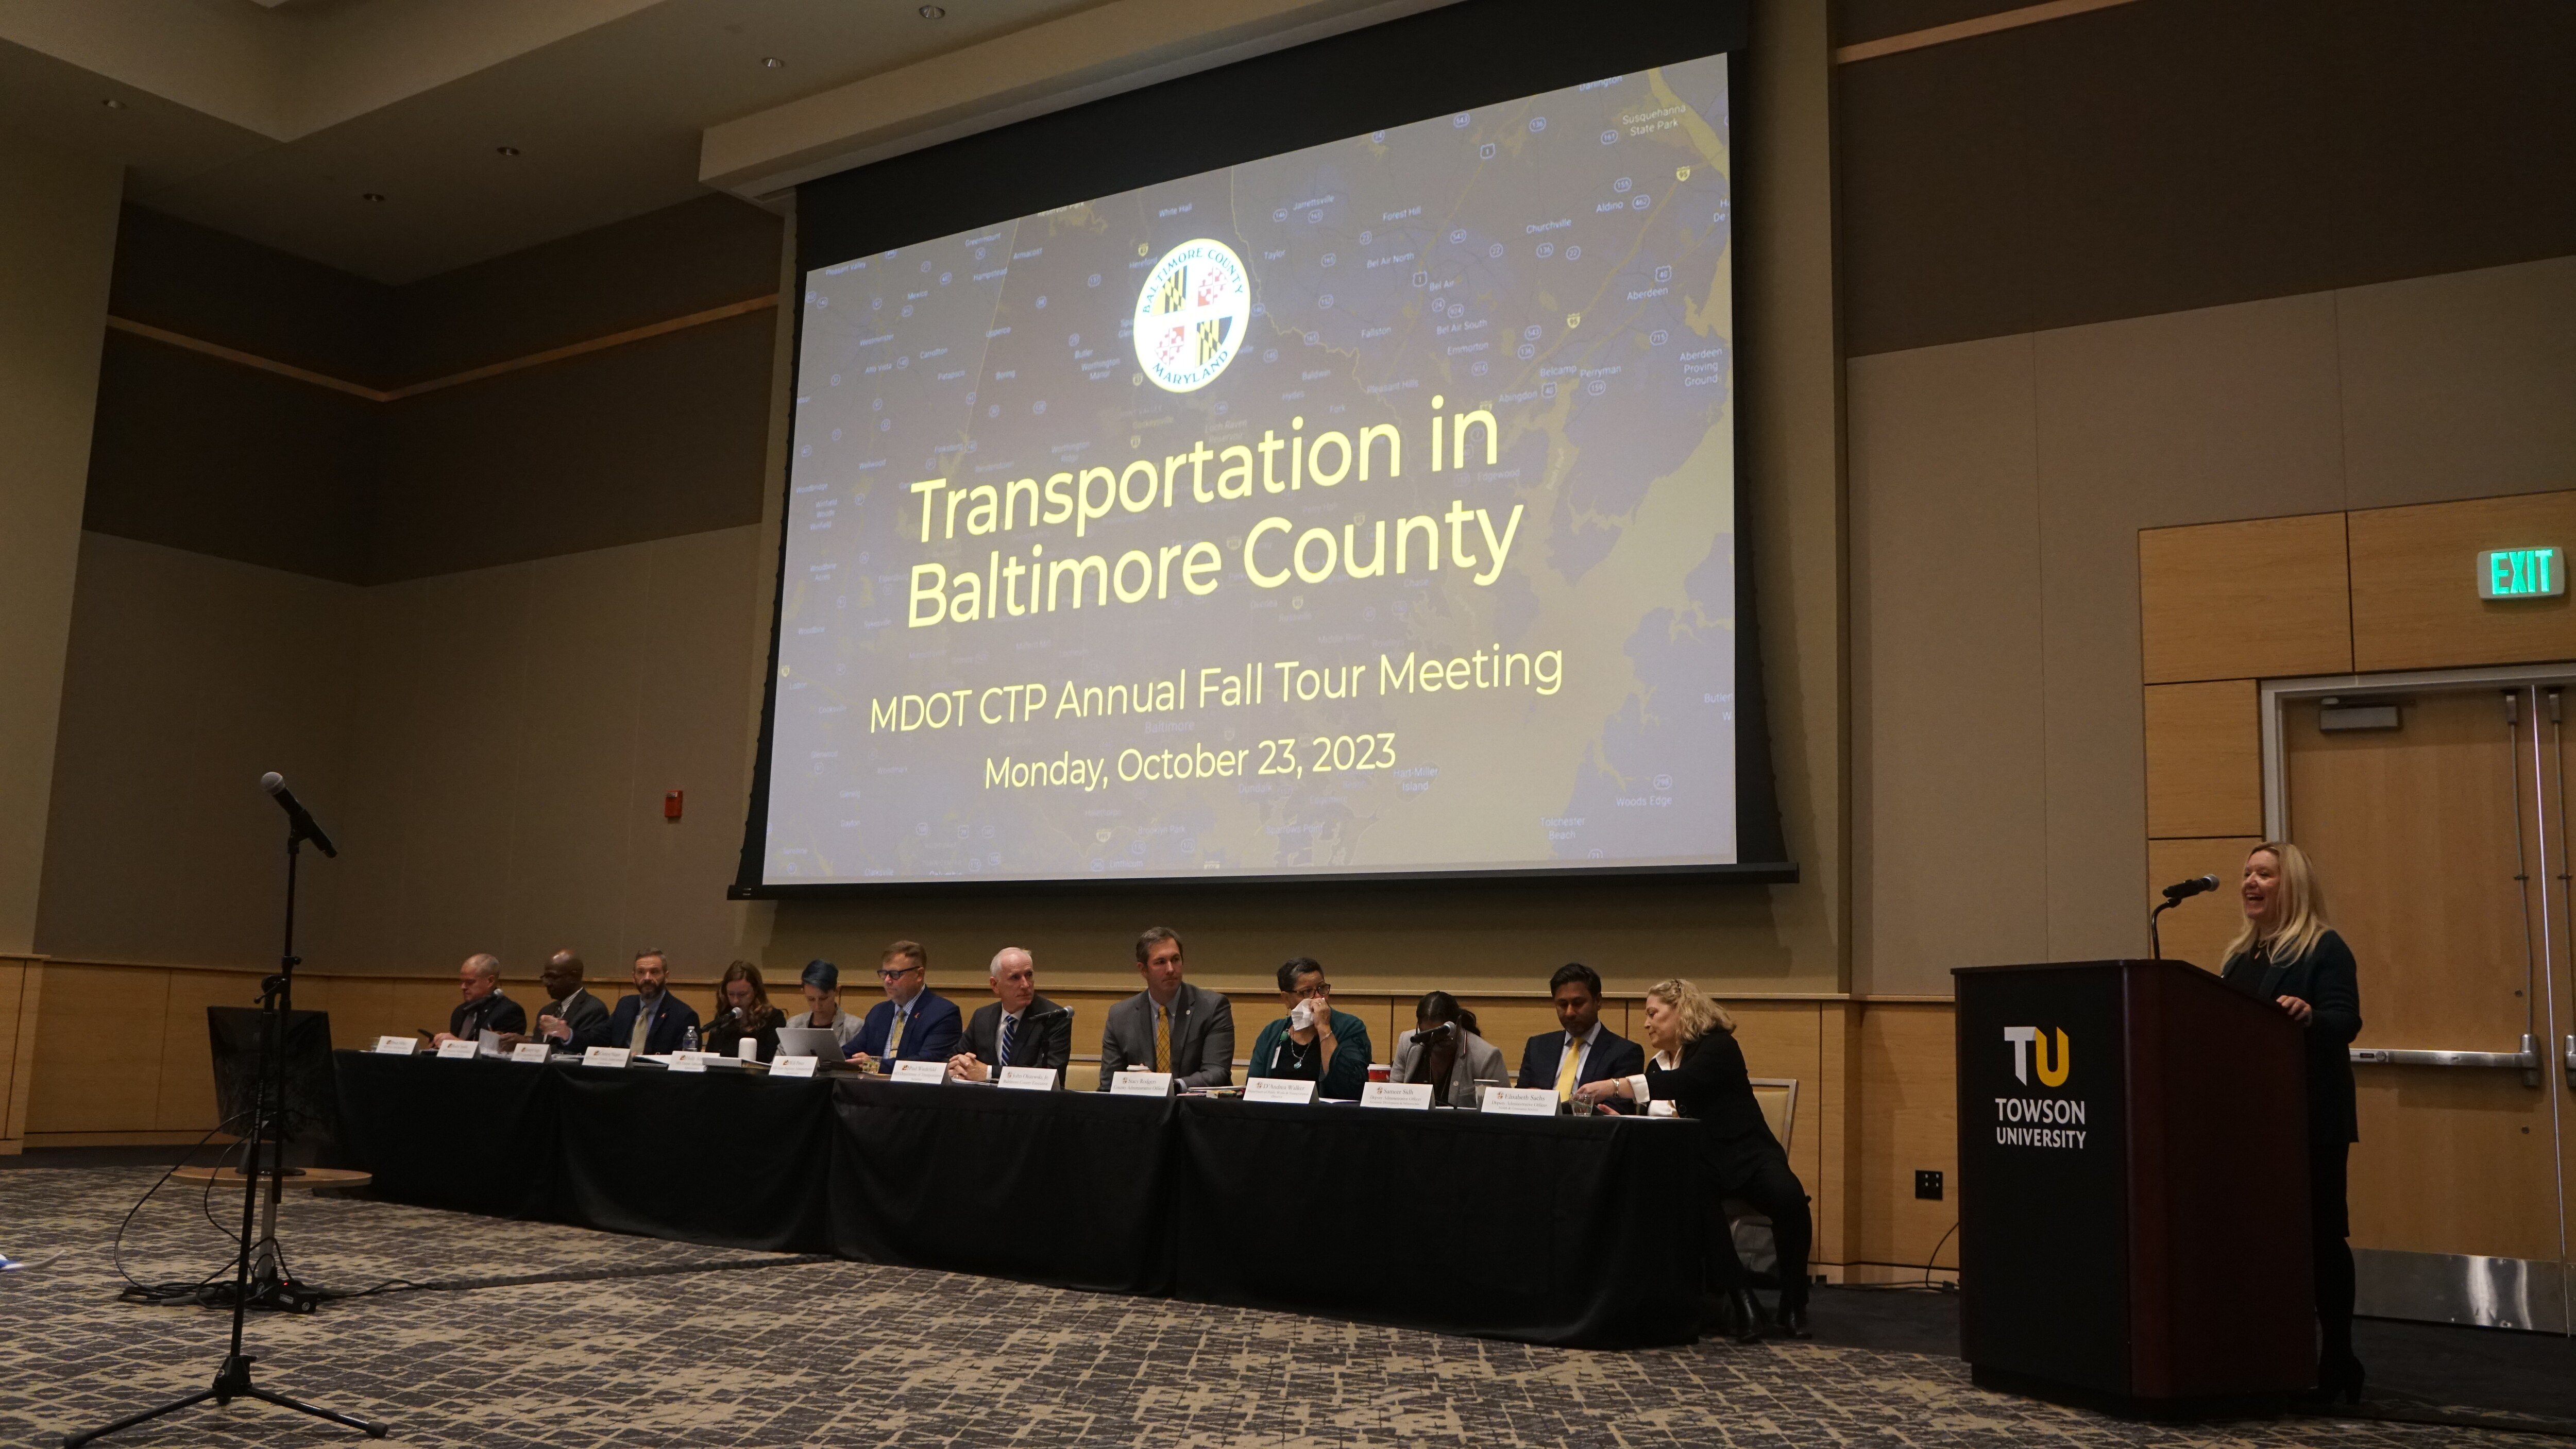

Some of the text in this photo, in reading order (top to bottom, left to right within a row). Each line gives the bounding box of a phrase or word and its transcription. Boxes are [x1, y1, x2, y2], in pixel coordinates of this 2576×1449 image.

[1623, 104, 1686, 126] Susquehanna
[1630, 118, 1679, 137] State Park
[1293, 195, 1334, 211] Jarrettsville
[1596, 200, 1623, 213] Aldino
[1383, 206, 1421, 221] Forest Hill
[1526, 217, 1572, 234] Churchville
[1264, 249, 1286, 260] Taylor
[1367, 252, 1414, 268] Bel Air North
[1142, 247, 1243, 314] BALTIMORE COUNTY
[1430, 282, 1443, 292] Bel
[1627, 286, 1668, 300] Aberdeen
[1362, 327, 1391, 338] Fallston
[1437, 325, 1449, 335] Bel
[1464, 319, 1487, 330] South
[1447, 342, 1489, 355] Emmorton
[1680, 348, 1722, 361] Aberdeen
[1153, 350, 1228, 384] MARYLAND
[1540, 364, 1577, 377] Belcamp
[1580, 365, 1621, 379] Perryman
[1684, 361, 1718, 374] Proving
[1684, 373, 1718, 387] Ground
[1499, 390, 1537, 403] Abingdon
[910, 416, 1401, 543] Transportation
[1431, 395, 1498, 472] in
[908, 499, 1525, 629] Baltimore County
[2490, 549, 2553, 595] EXIT
[870, 642, 1563, 734] MDOT CTP Annual Fall Tour Meeting
[1145, 721, 1195, 734] Baltimore
[985, 732, 1396, 792] Monday, October 23, 2023
[1402, 781, 1429, 792] Island
[1616, 795, 1672, 807] Woods Edge
[1541, 816, 1585, 827] Tolchester
[1549, 830, 1575, 841] Beach
[2004, 1026, 2070, 1087] TU
[1995, 1098, 2086, 1124] TOWSON
[1996, 1127, 2087, 1149] UNIVERSITY
